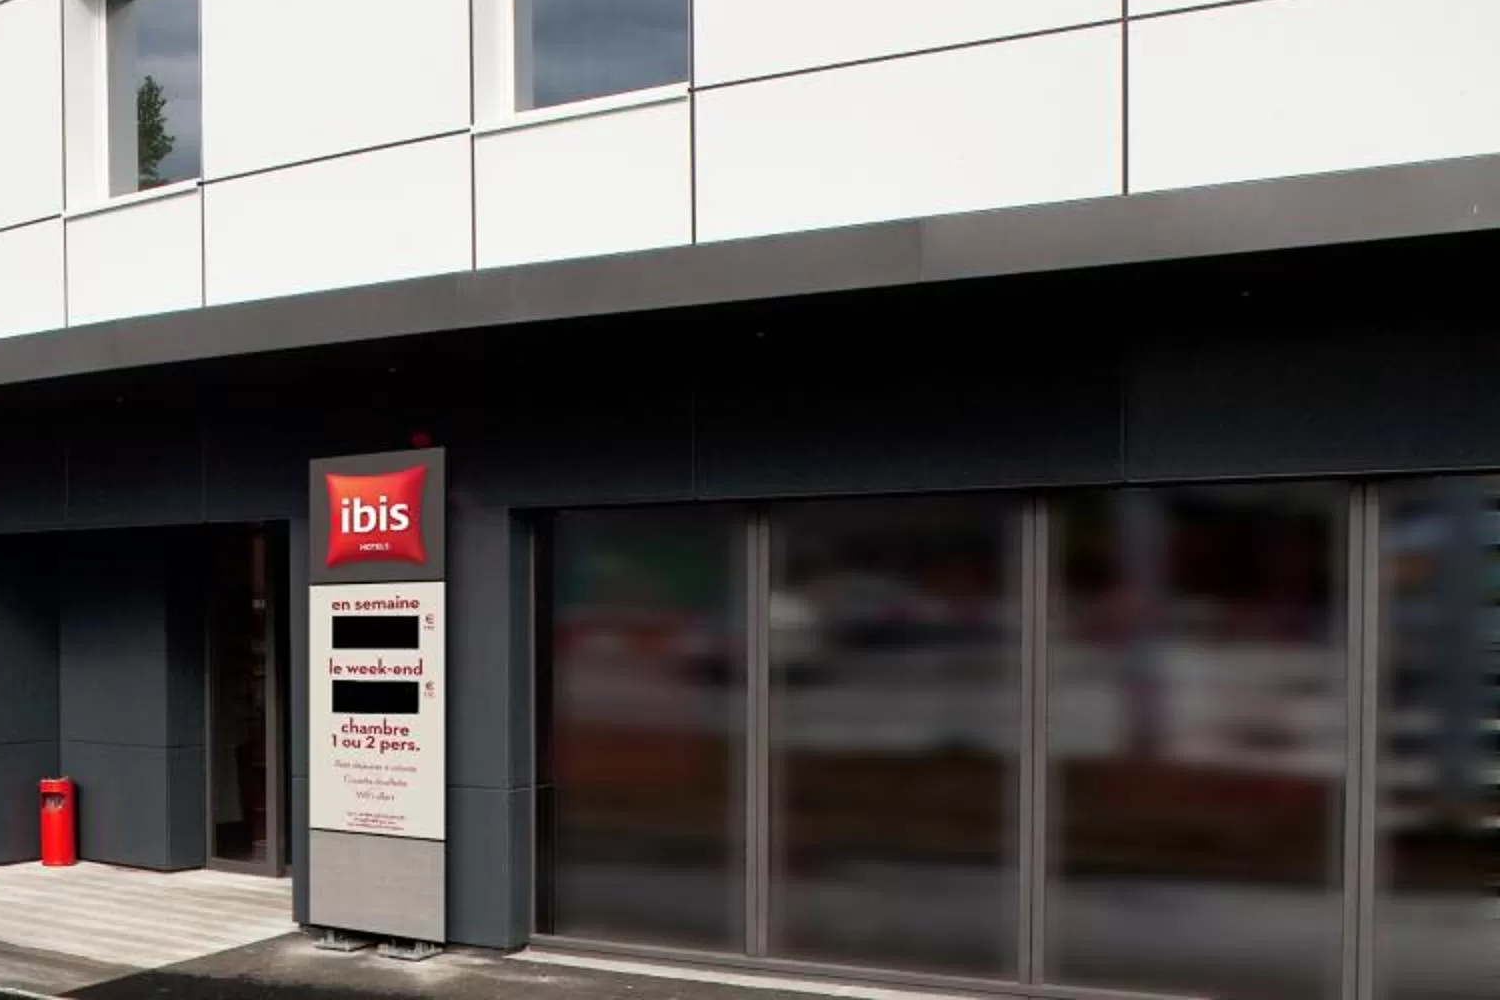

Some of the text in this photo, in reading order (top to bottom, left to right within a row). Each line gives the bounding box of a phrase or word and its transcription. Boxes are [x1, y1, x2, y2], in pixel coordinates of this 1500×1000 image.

[341, 495, 410, 534] ibis
[331, 594, 420, 611] en semaine
[329, 657, 423, 676] le week-end
[341, 716, 410, 736] chambre
[331, 733, 421, 754] 1 ou 2 pers.
